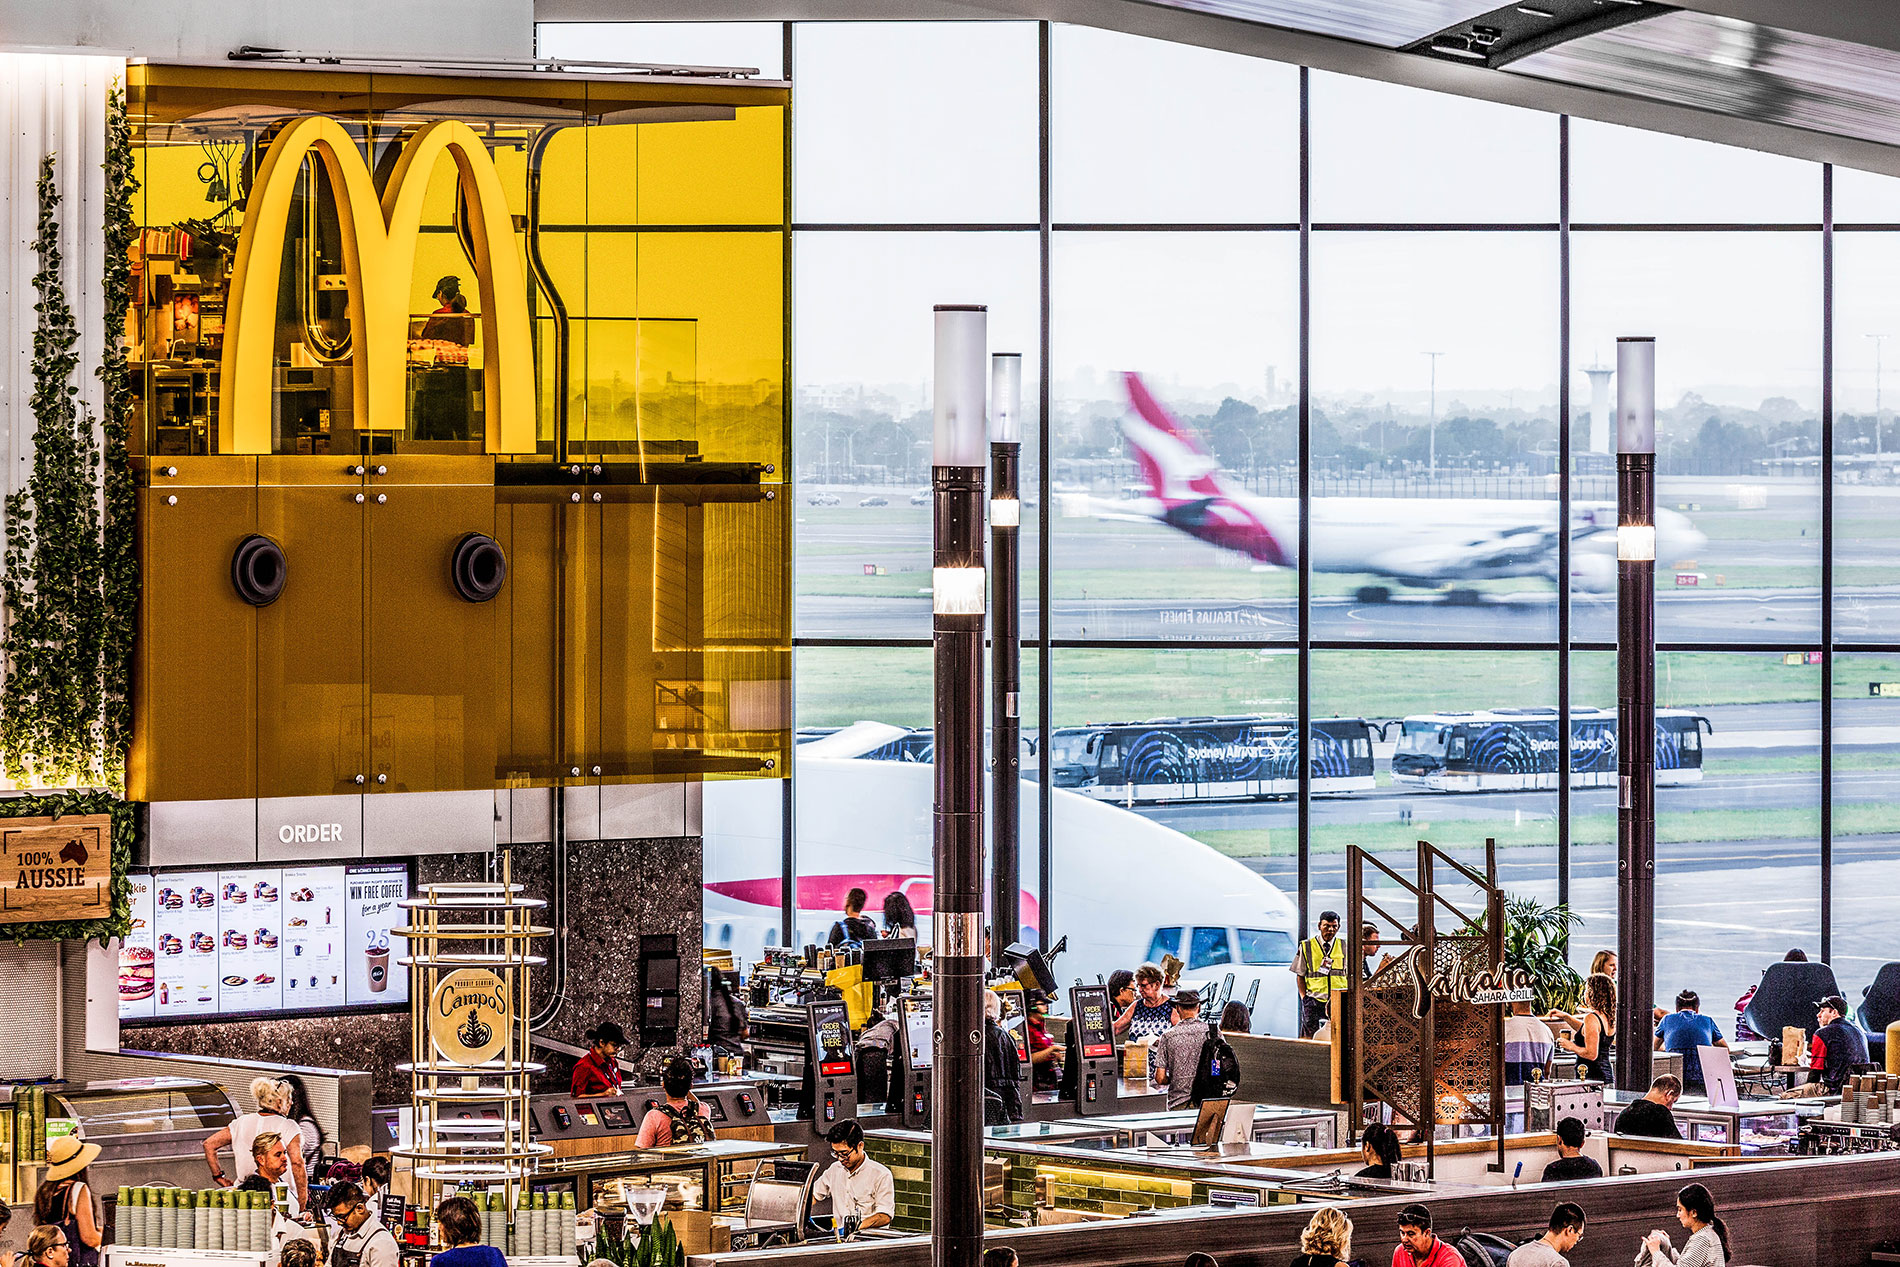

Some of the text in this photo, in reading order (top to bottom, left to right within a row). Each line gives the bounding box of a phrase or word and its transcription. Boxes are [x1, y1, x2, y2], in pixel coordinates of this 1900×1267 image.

[1187, 745, 1262, 761] Sydney Airport
[1530, 739, 1559, 752] Sydne
[279, 824, 343, 844] ORDER
[16, 851, 54, 867] 100%
[16, 867, 85, 889] AUSSIE
[350, 886, 362, 899] WIN
[364, 885, 379, 899] FREE
[380, 884, 403, 899] COFFEE
[361, 904, 371, 917] for
[377, 901, 392, 914] year
[1472, 990, 1534, 1003] SAHARA GRILL
[1086, 1021, 1103, 1030] HERE
[824, 1038, 842, 1047] HERE
